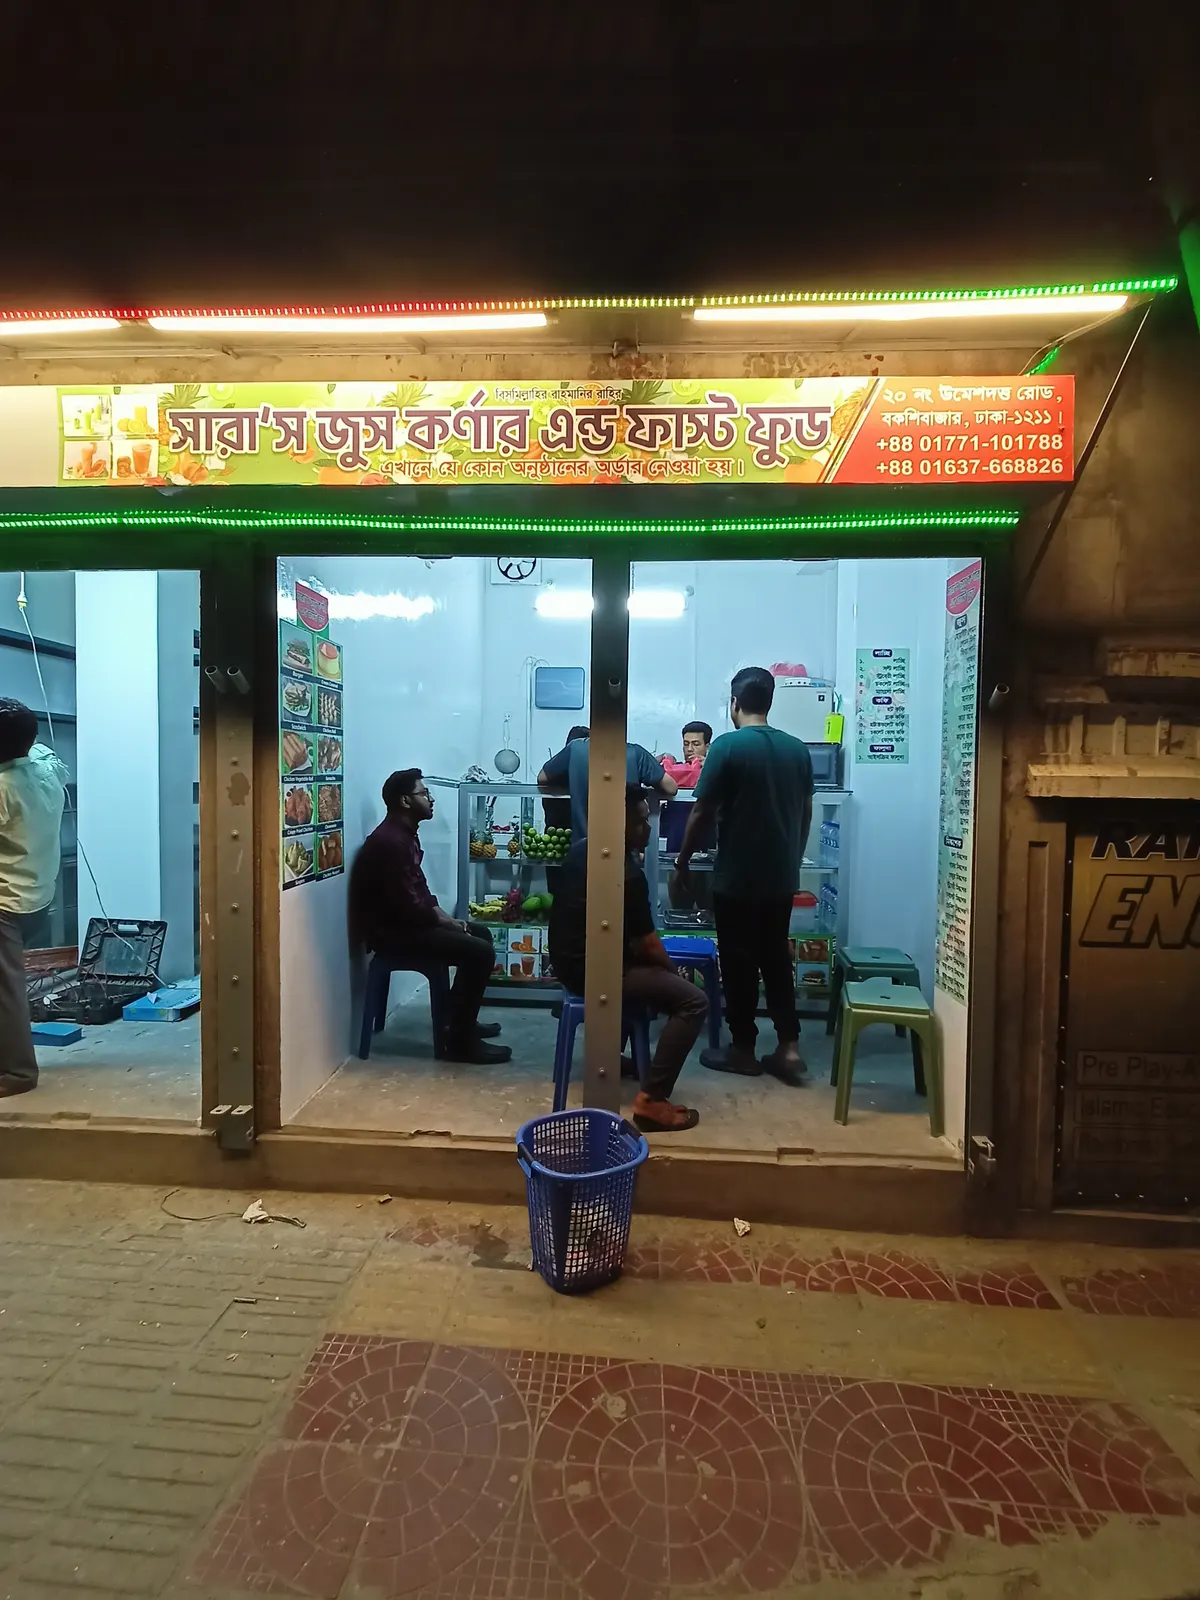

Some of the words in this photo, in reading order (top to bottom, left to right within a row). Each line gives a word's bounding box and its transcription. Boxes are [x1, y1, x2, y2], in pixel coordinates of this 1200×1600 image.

[882, 389, 906, 404] ২০
[912, 388, 934, 403] নং
[315, 410, 396, 470] জুস
[405, 389, 530, 455] কর্ণার
[540, 407, 618, 453] এন্ড
[625, 393, 738, 451] ফাস্ট
[745, 406, 832, 466] ফুড
[876, 435, 913, 452] +88
[919, 434, 1064, 452] 01771-101788
[380, 459, 432, 478] এখানে
[439, 459, 457, 477] যে
[462, 459, 503, 478] কোন
[511, 455, 589, 479] অনুষ্ঠানের
[595, 454, 643, 478] অর্ডার
[647, 458, 700, 476] নেওয়া
[876, 459, 913, 476] +88
[919, 457, 1064, 475] 01637-668826
